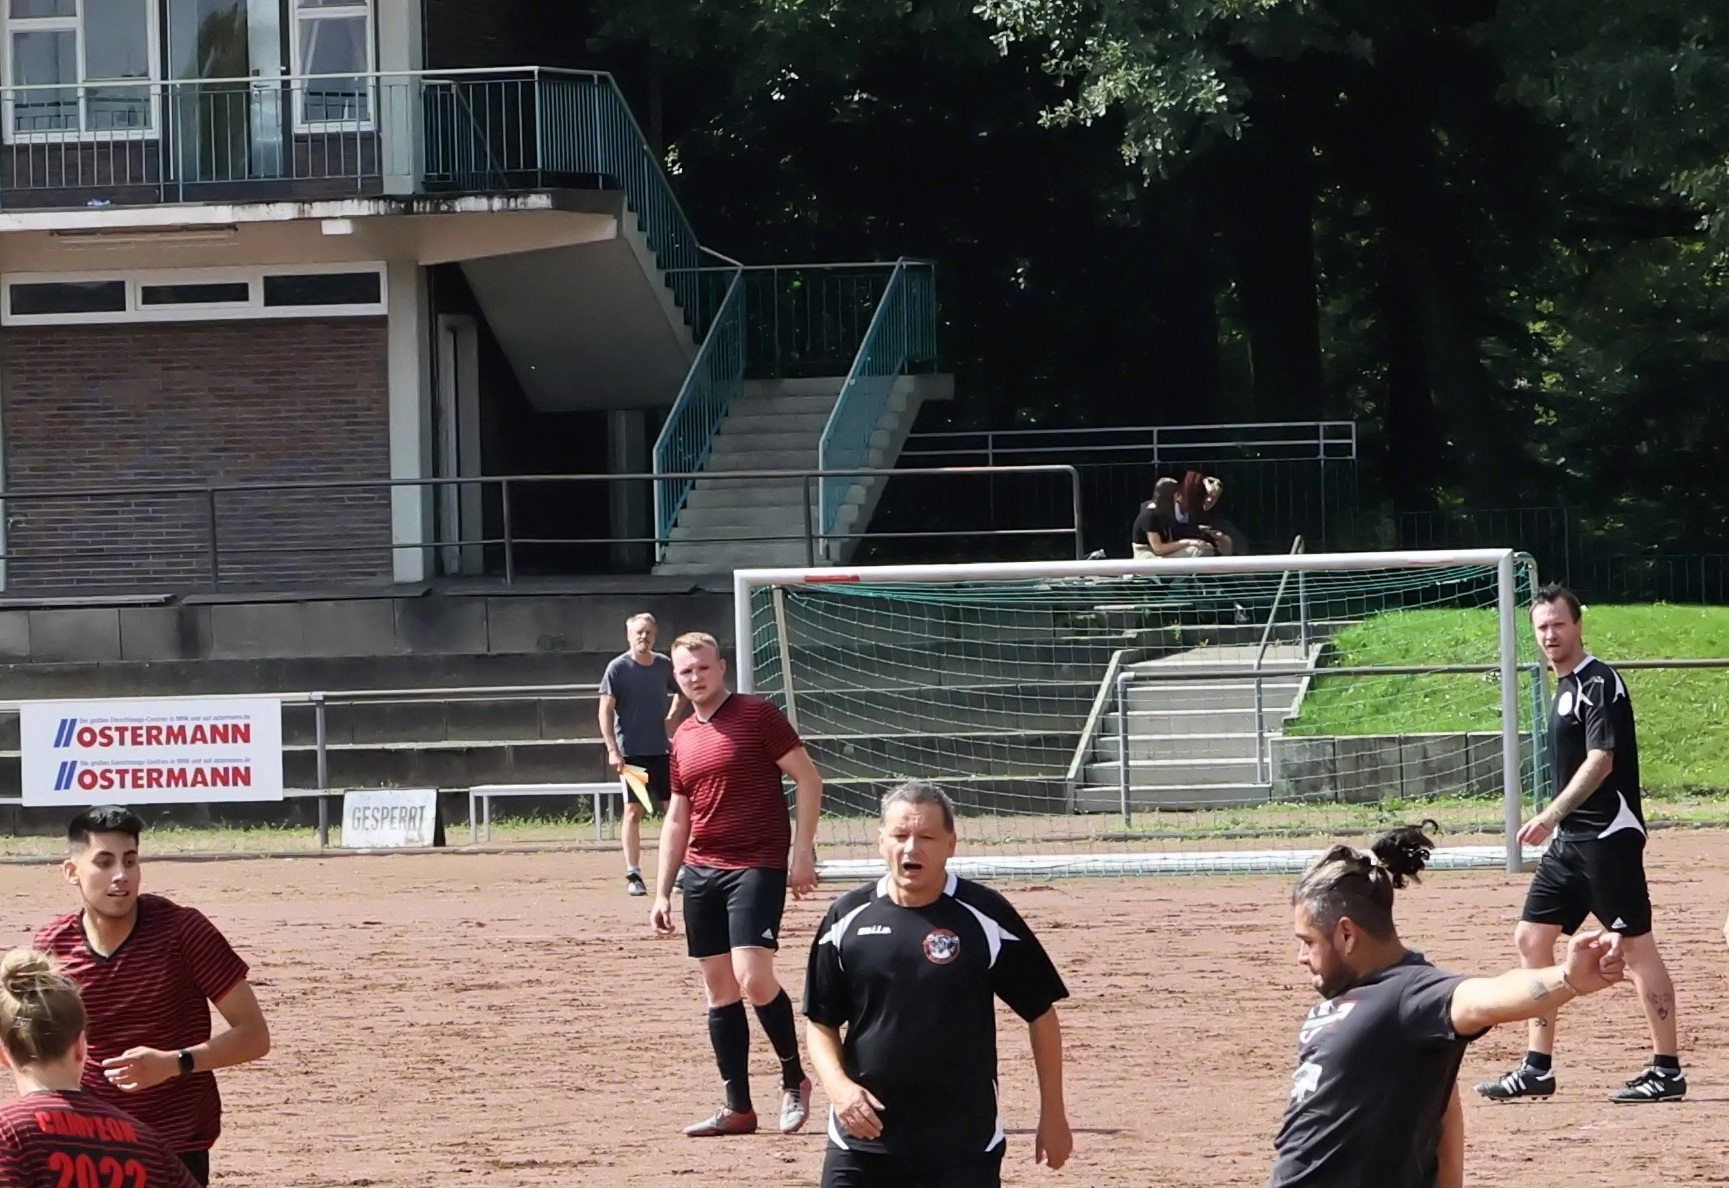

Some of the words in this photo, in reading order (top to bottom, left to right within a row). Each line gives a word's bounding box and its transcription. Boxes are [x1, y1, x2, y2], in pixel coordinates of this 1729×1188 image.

[77, 723, 251, 748] OSTERMANN
[77, 767, 251, 790] OSTERMANN
[352, 805, 426, 831] GESPERRT
